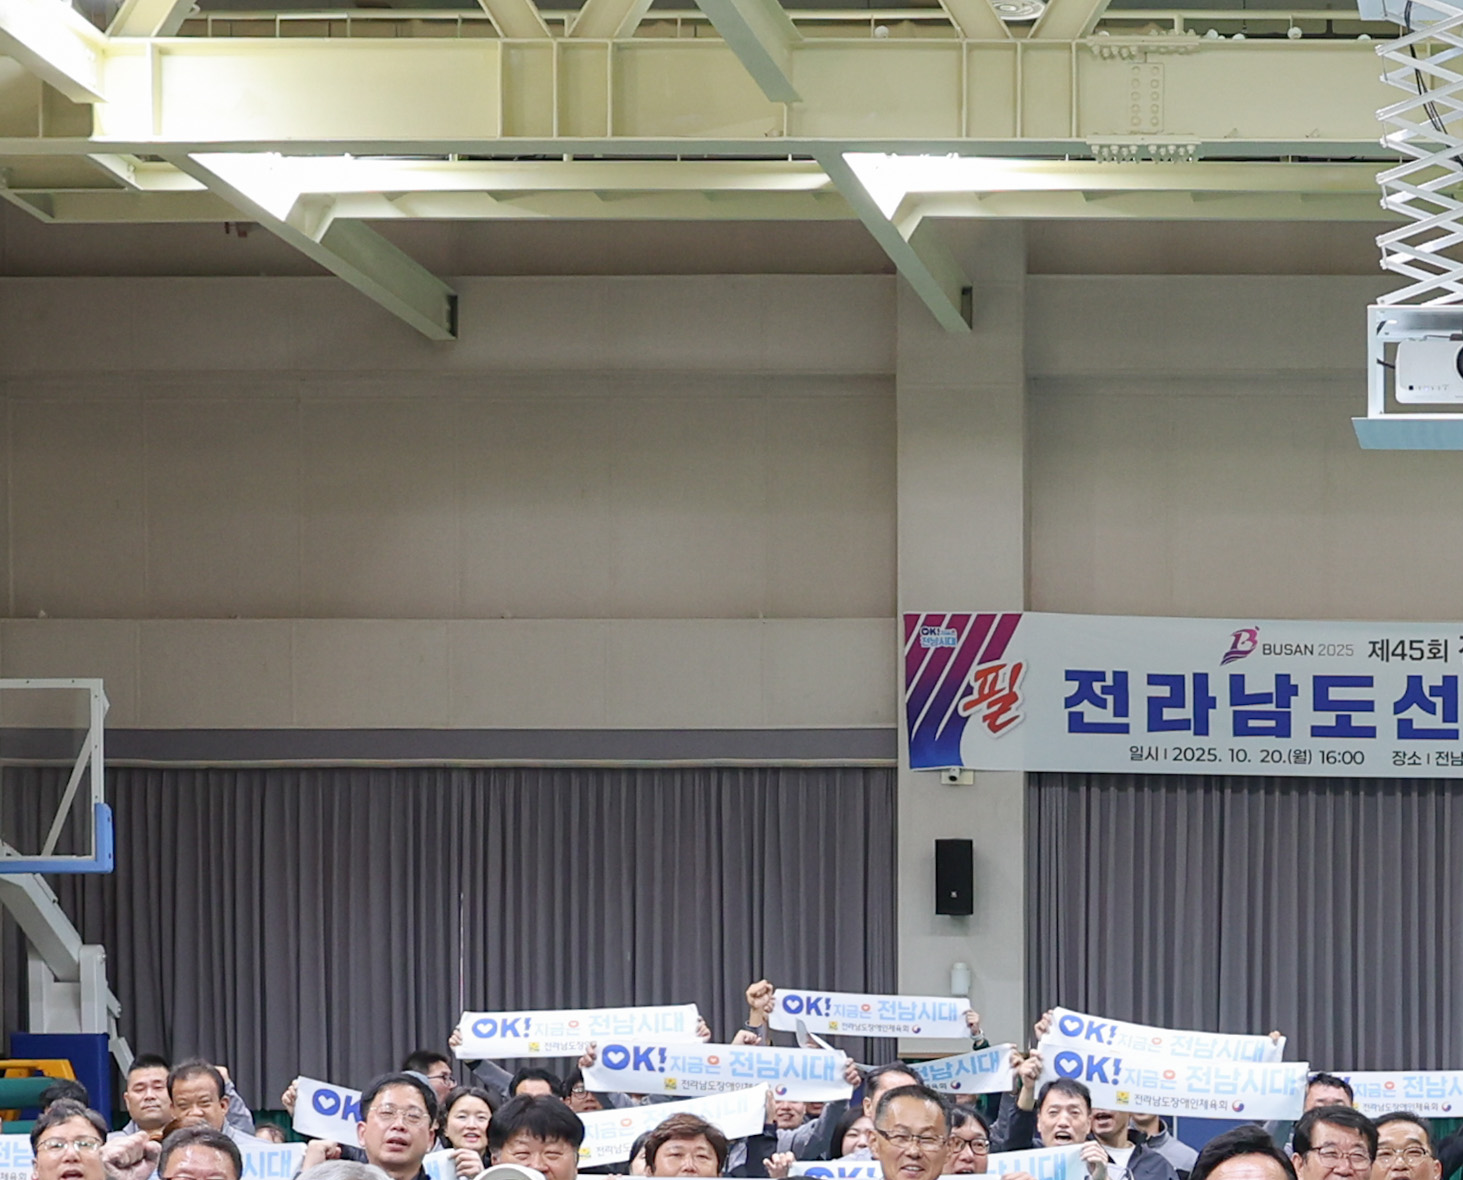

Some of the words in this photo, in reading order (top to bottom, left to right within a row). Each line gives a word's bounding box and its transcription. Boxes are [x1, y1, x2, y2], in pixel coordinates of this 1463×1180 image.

[1262, 642, 1314, 657] BUSAN
[1318, 643, 1354, 657] 2025
[1368, 638, 1449, 663] 제45회
[963, 662, 1024, 735] 필
[1129, 745, 1160, 763] 일시
[1172, 746, 1222, 763] 2025.
[1229, 747, 1252, 763] 10.
[1260, 748, 1312, 765] 20.(월)
[1319, 750, 1365, 766] 16:00
[1392, 750, 1422, 767] 장소
[782, 994, 830, 1017] OK!
[833, 1003, 871, 1018] 지금은
[877, 999, 959, 1022] 전남시대
[471, 1017, 532, 1039] OK!
[535, 1020, 580, 1037] 지금은
[588, 1012, 685, 1036] 전남시대
[1059, 1014, 1119, 1046] OK!
[1118, 1032, 1163, 1054] 지금은
[1170, 1034, 1266, 1063] 전남시대
[601, 1043, 668, 1073] OK!
[670, 1054, 722, 1075] 지금은
[728, 1048, 836, 1082] 전남시대
[1053, 1050, 1122, 1086] OK!
[1123, 1068, 1177, 1090] 지금은
[1184, 1064, 1296, 1097] 전남시대
[1355, 1080, 1396, 1098] 지금은
[311, 1088, 363, 1123] OK
